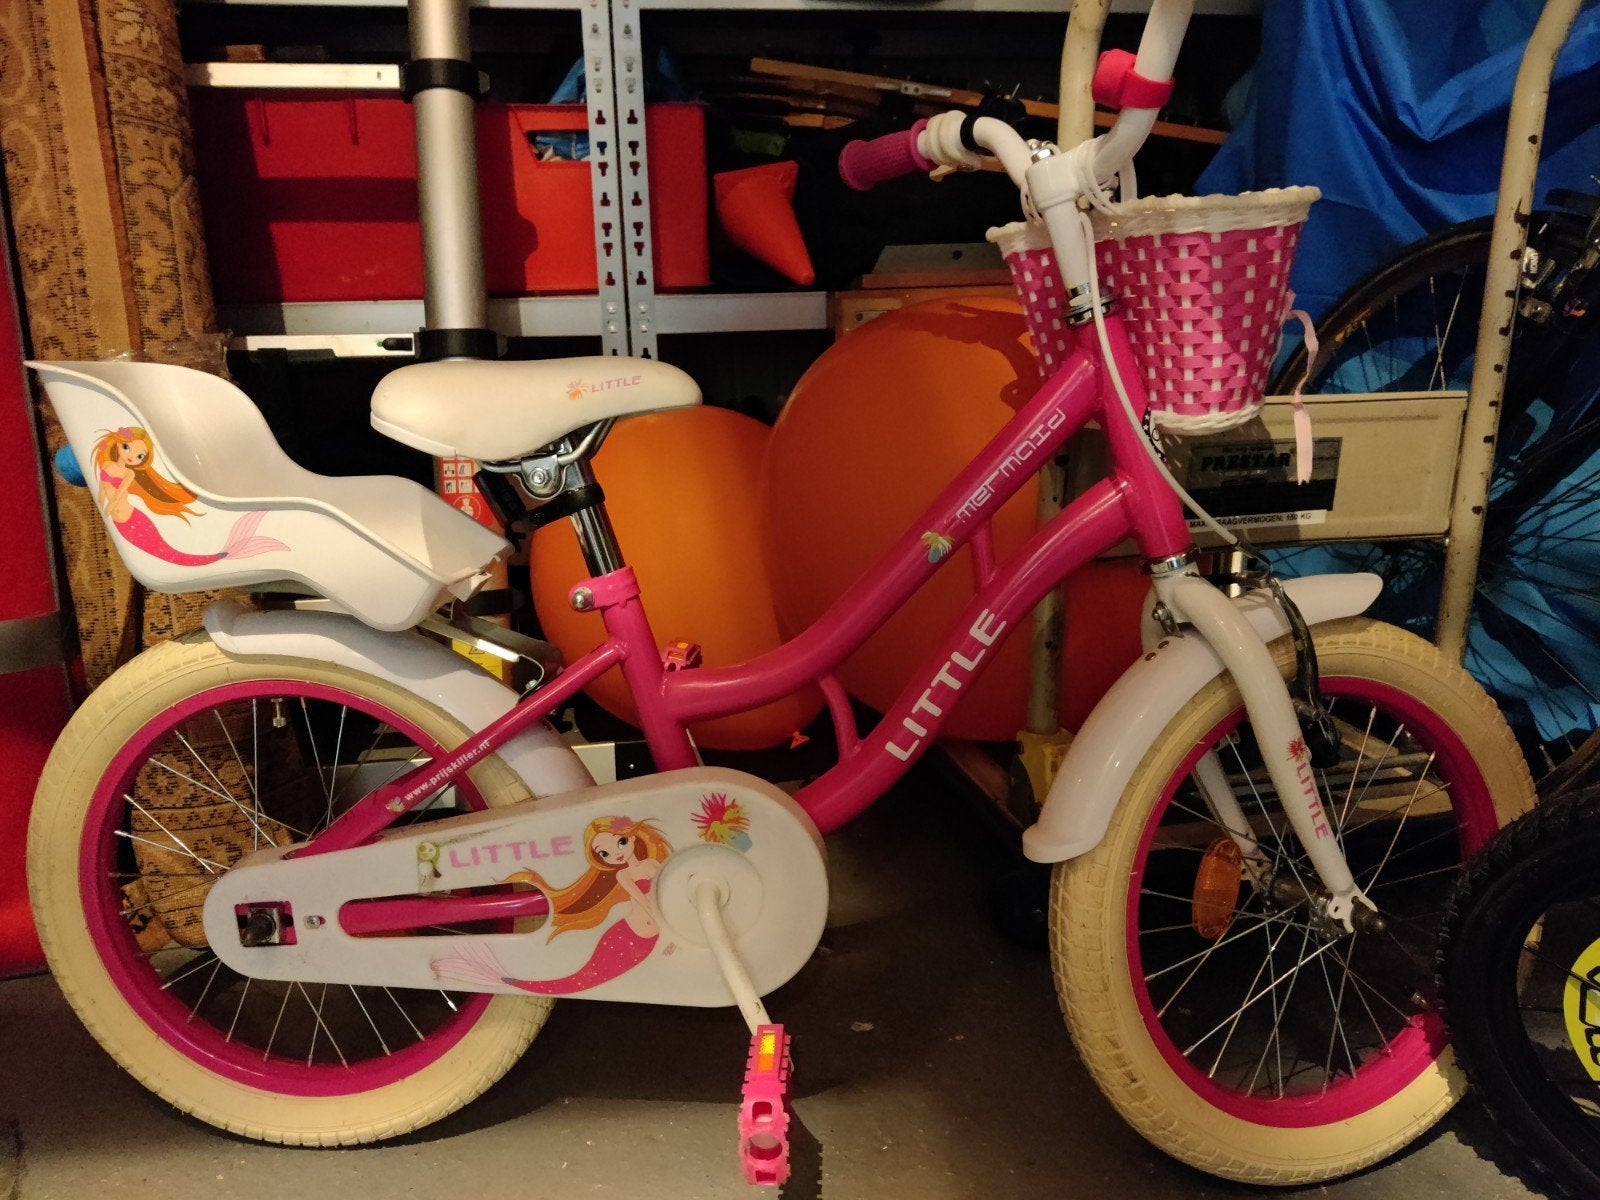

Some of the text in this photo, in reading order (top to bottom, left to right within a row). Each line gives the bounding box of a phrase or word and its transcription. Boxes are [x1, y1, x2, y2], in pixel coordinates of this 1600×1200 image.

[591, 375, 642, 393] LITTLE
[955, 407, 1067, 520] mermaid
[1200, 452, 1291, 472] PRESTAR
[1215, 514, 1283, 526] RAAGVERMOGEN:
[1286, 513, 1299, 521] 150
[1301, 512, 1312, 520] KG
[884, 608, 1007, 762] LITTLE
[1296, 762, 1329, 840] LITTLE
[450, 835, 575, 869] LITTLE
